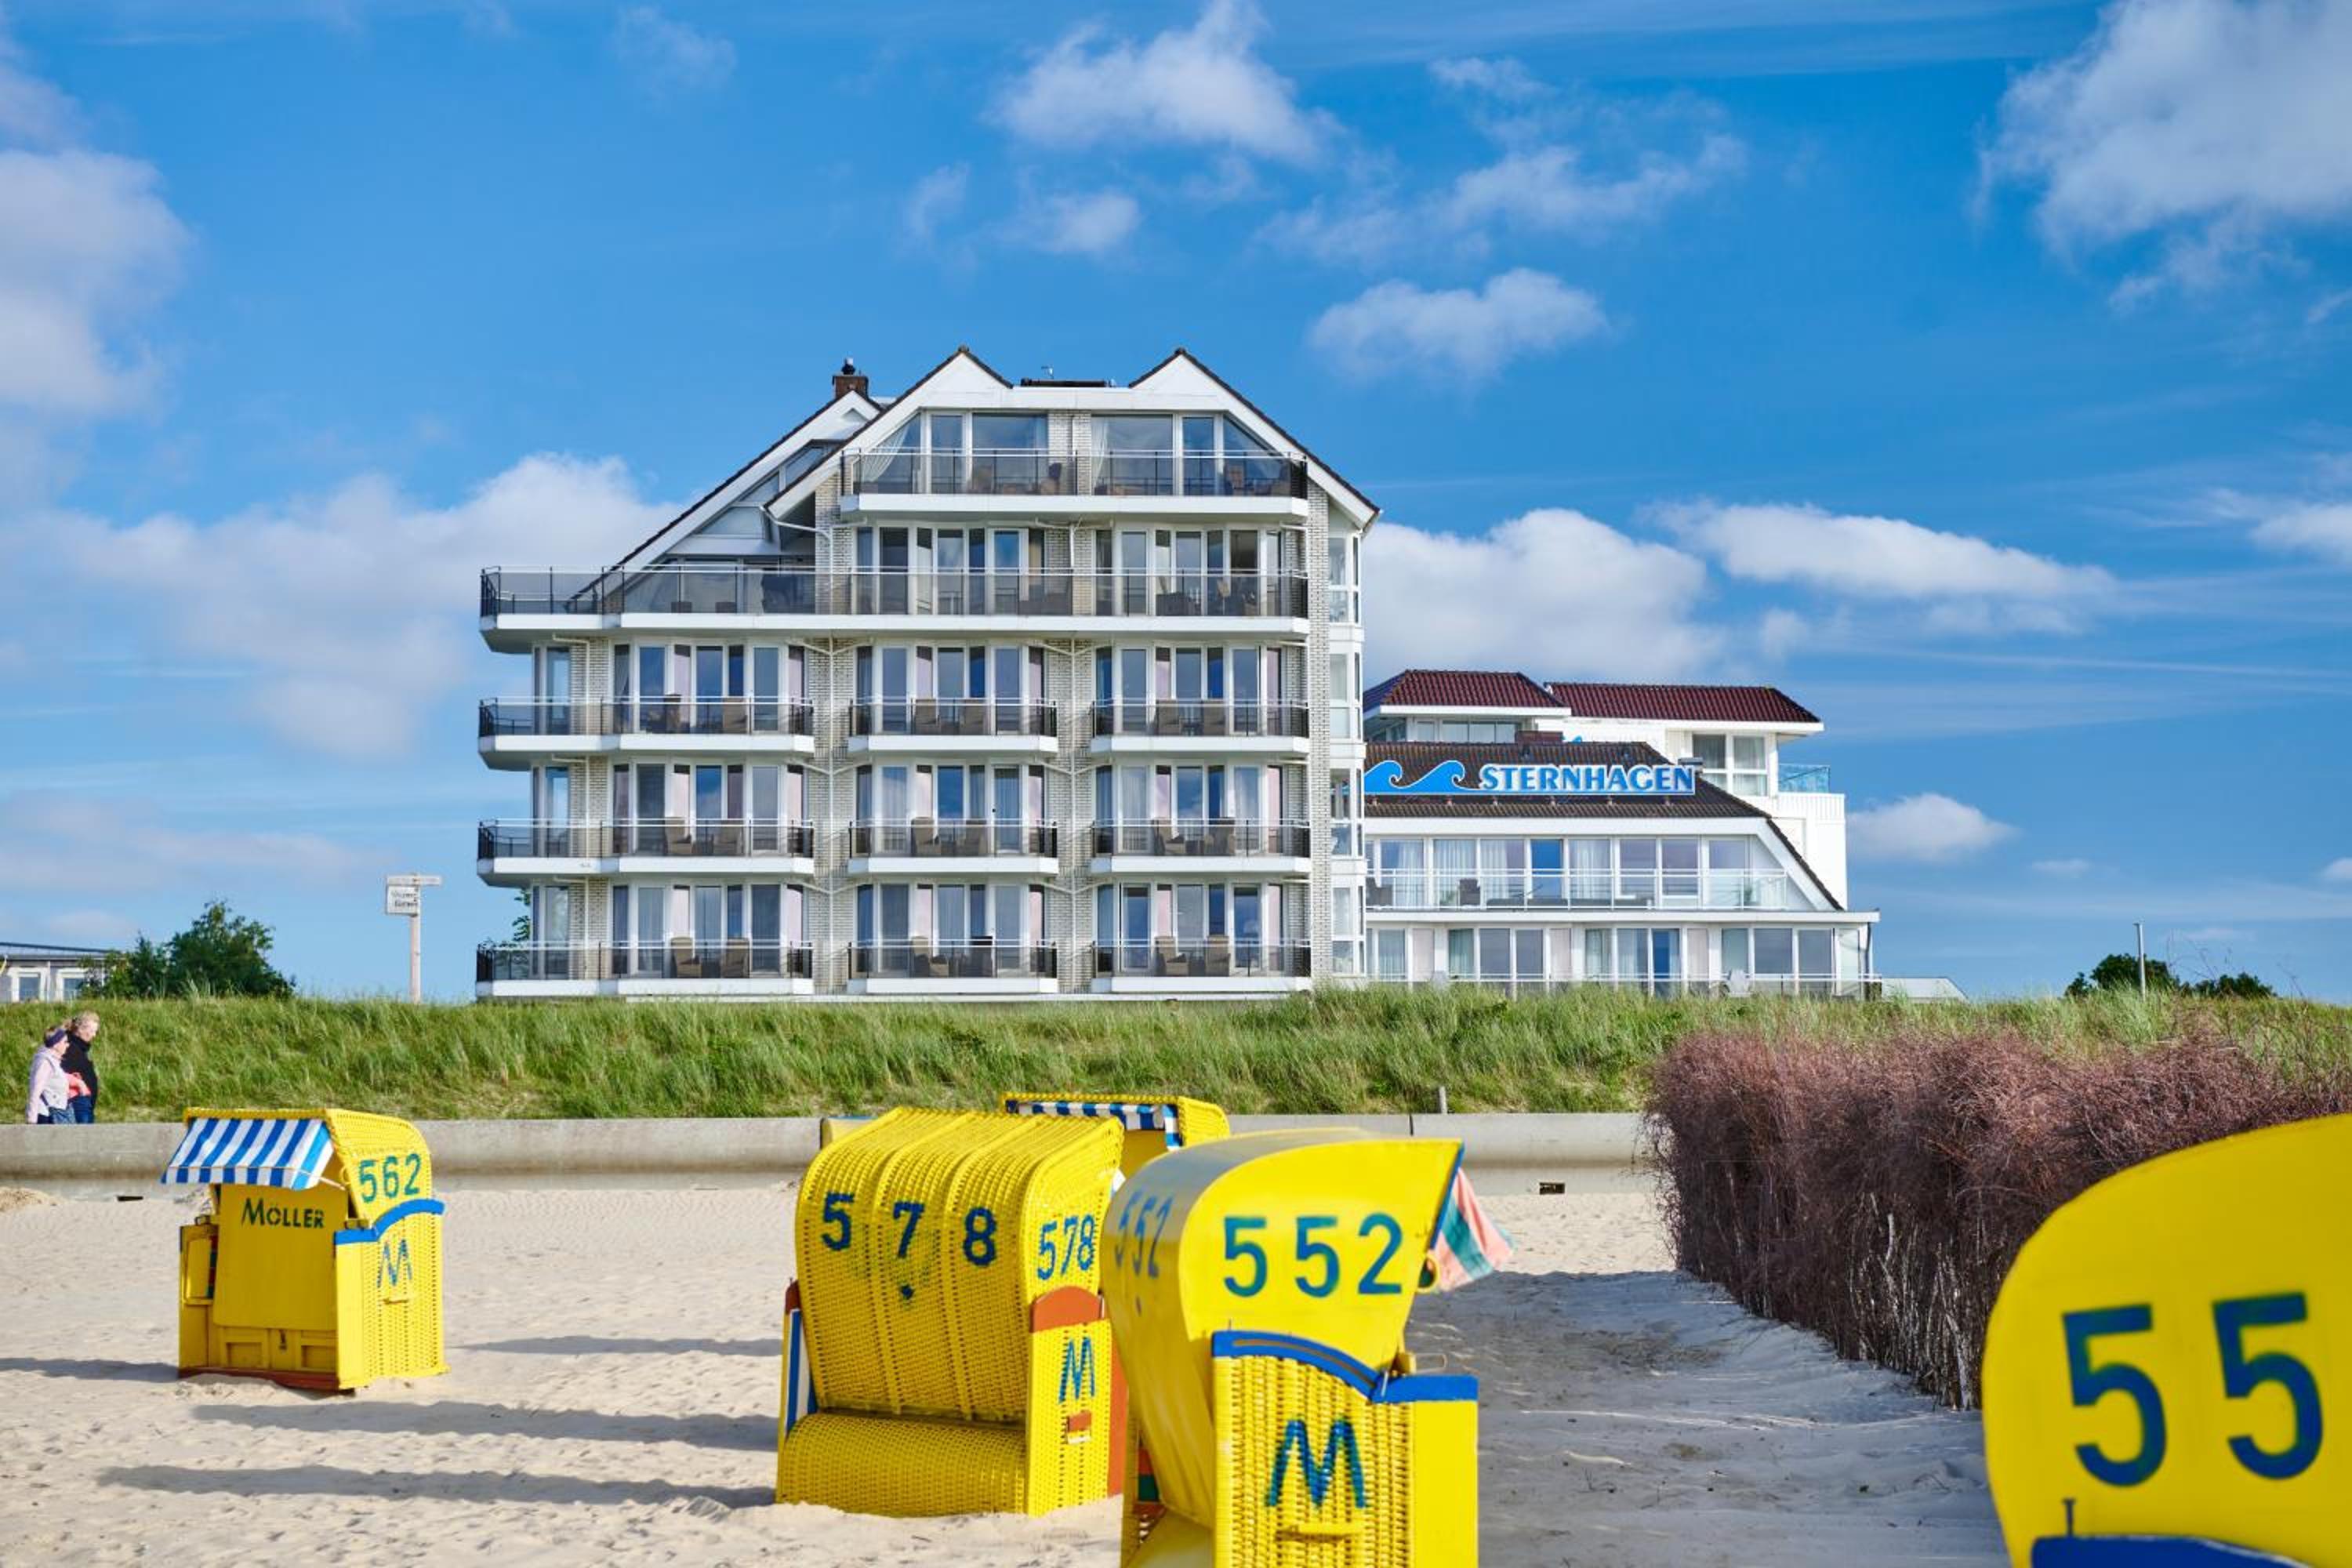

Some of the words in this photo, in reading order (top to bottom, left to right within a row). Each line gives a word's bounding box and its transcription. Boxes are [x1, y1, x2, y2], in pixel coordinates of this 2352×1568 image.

[1482, 765, 1693, 791] STERNHAGEN
[358, 1152, 422, 1203] 562
[377, 1238, 413, 1288] M
[1037, 1214, 1095, 1281] 578
[1223, 1213, 1403, 1298] 552
[1058, 1337, 1096, 1404] M
[1265, 1419, 1368, 1508] M
